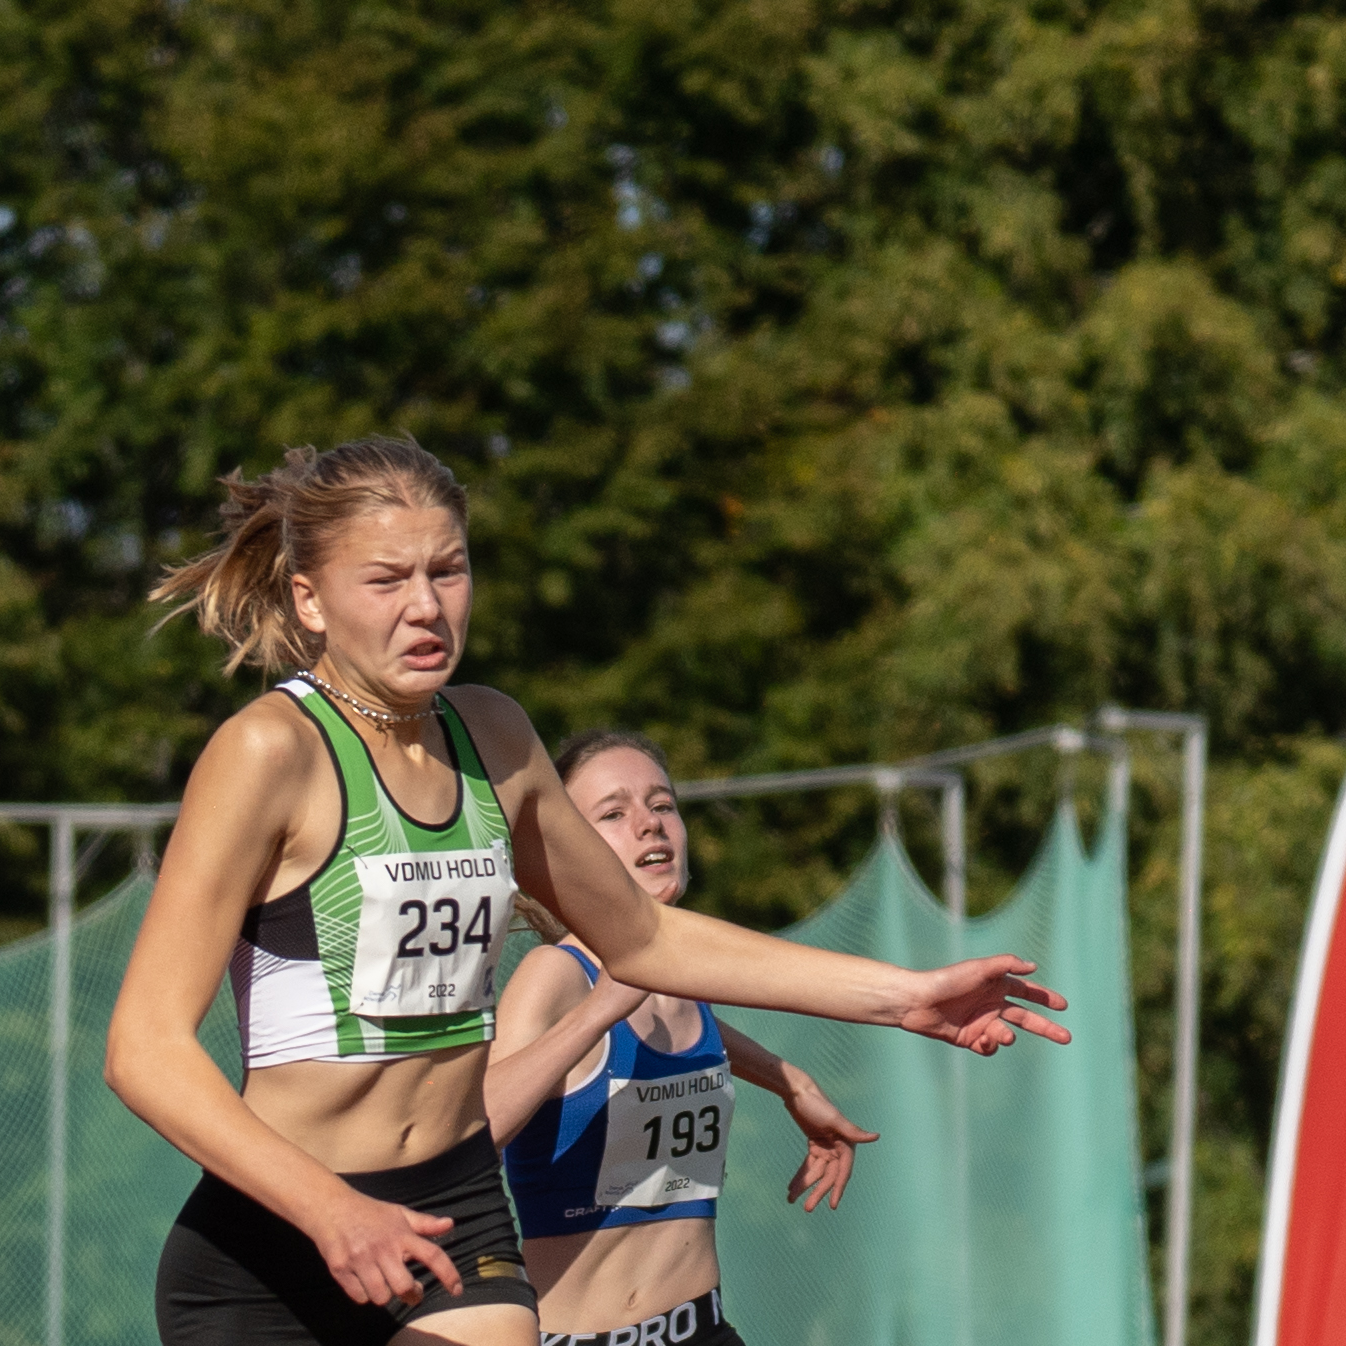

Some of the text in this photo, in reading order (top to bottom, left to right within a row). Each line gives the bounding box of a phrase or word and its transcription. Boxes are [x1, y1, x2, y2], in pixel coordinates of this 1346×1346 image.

[385, 858, 496, 882] VDMU HOLD
[397, 896, 492, 958] 234
[428, 984, 456, 998] 2022
[636, 1072, 725, 1103] VDMU HOLD
[643, 1105, 721, 1160] 193
[665, 1177, 690, 1192] 2022
[564, 1206, 607, 1218] CRAFT
